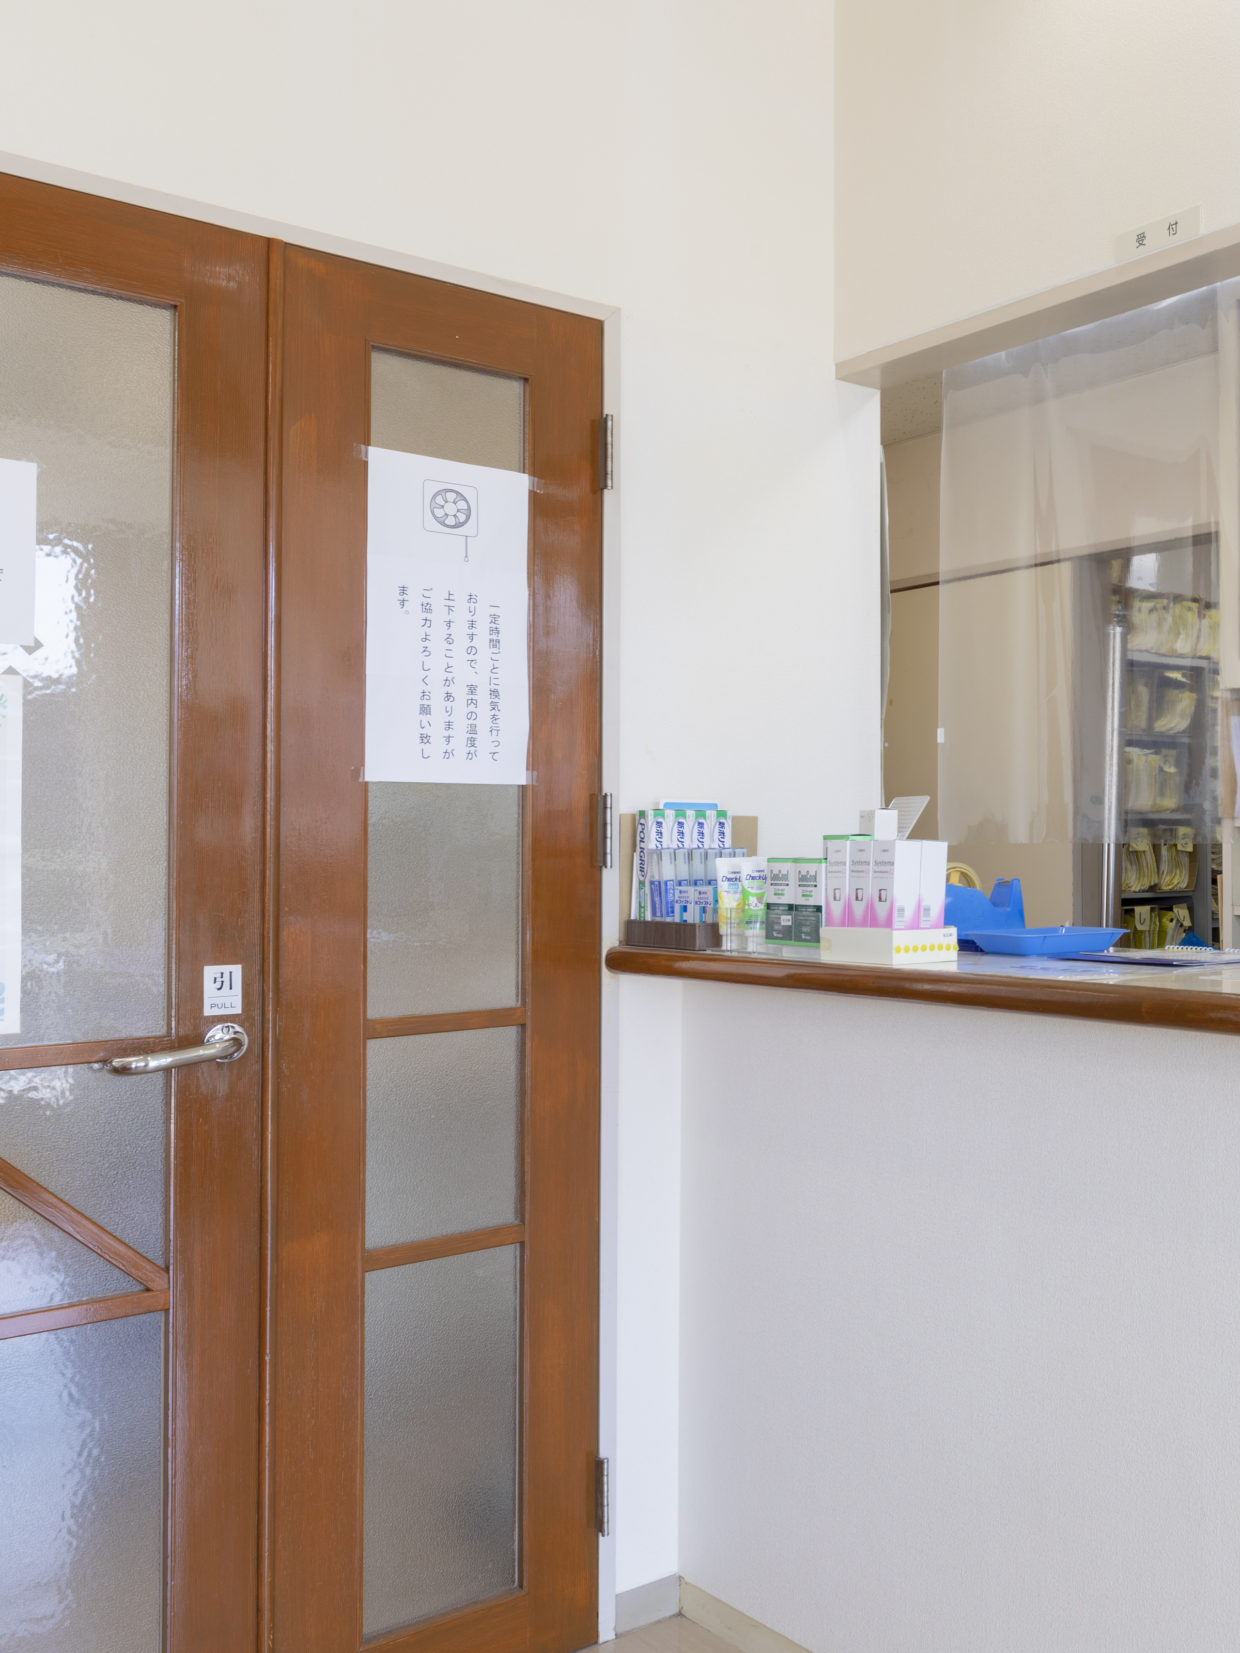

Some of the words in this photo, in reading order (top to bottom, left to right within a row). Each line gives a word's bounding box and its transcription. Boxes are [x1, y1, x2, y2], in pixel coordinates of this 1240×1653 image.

[1136, 220, 1178, 248] 受付
[397, 584, 410, 615] ます。
[419, 586, 433, 760] ご協力よろしくお願い致し
[443, 590, 455, 760] 上下することがありますが
[466, 592, 478, 761] おりますので、室内の温度が
[488, 603, 501, 762] 一定時間ごとに換気を行って
[638, 822, 646, 878] POLIGRIP
[210, 1002, 237, 1010] PULL
[213, 971, 233, 991] 引
